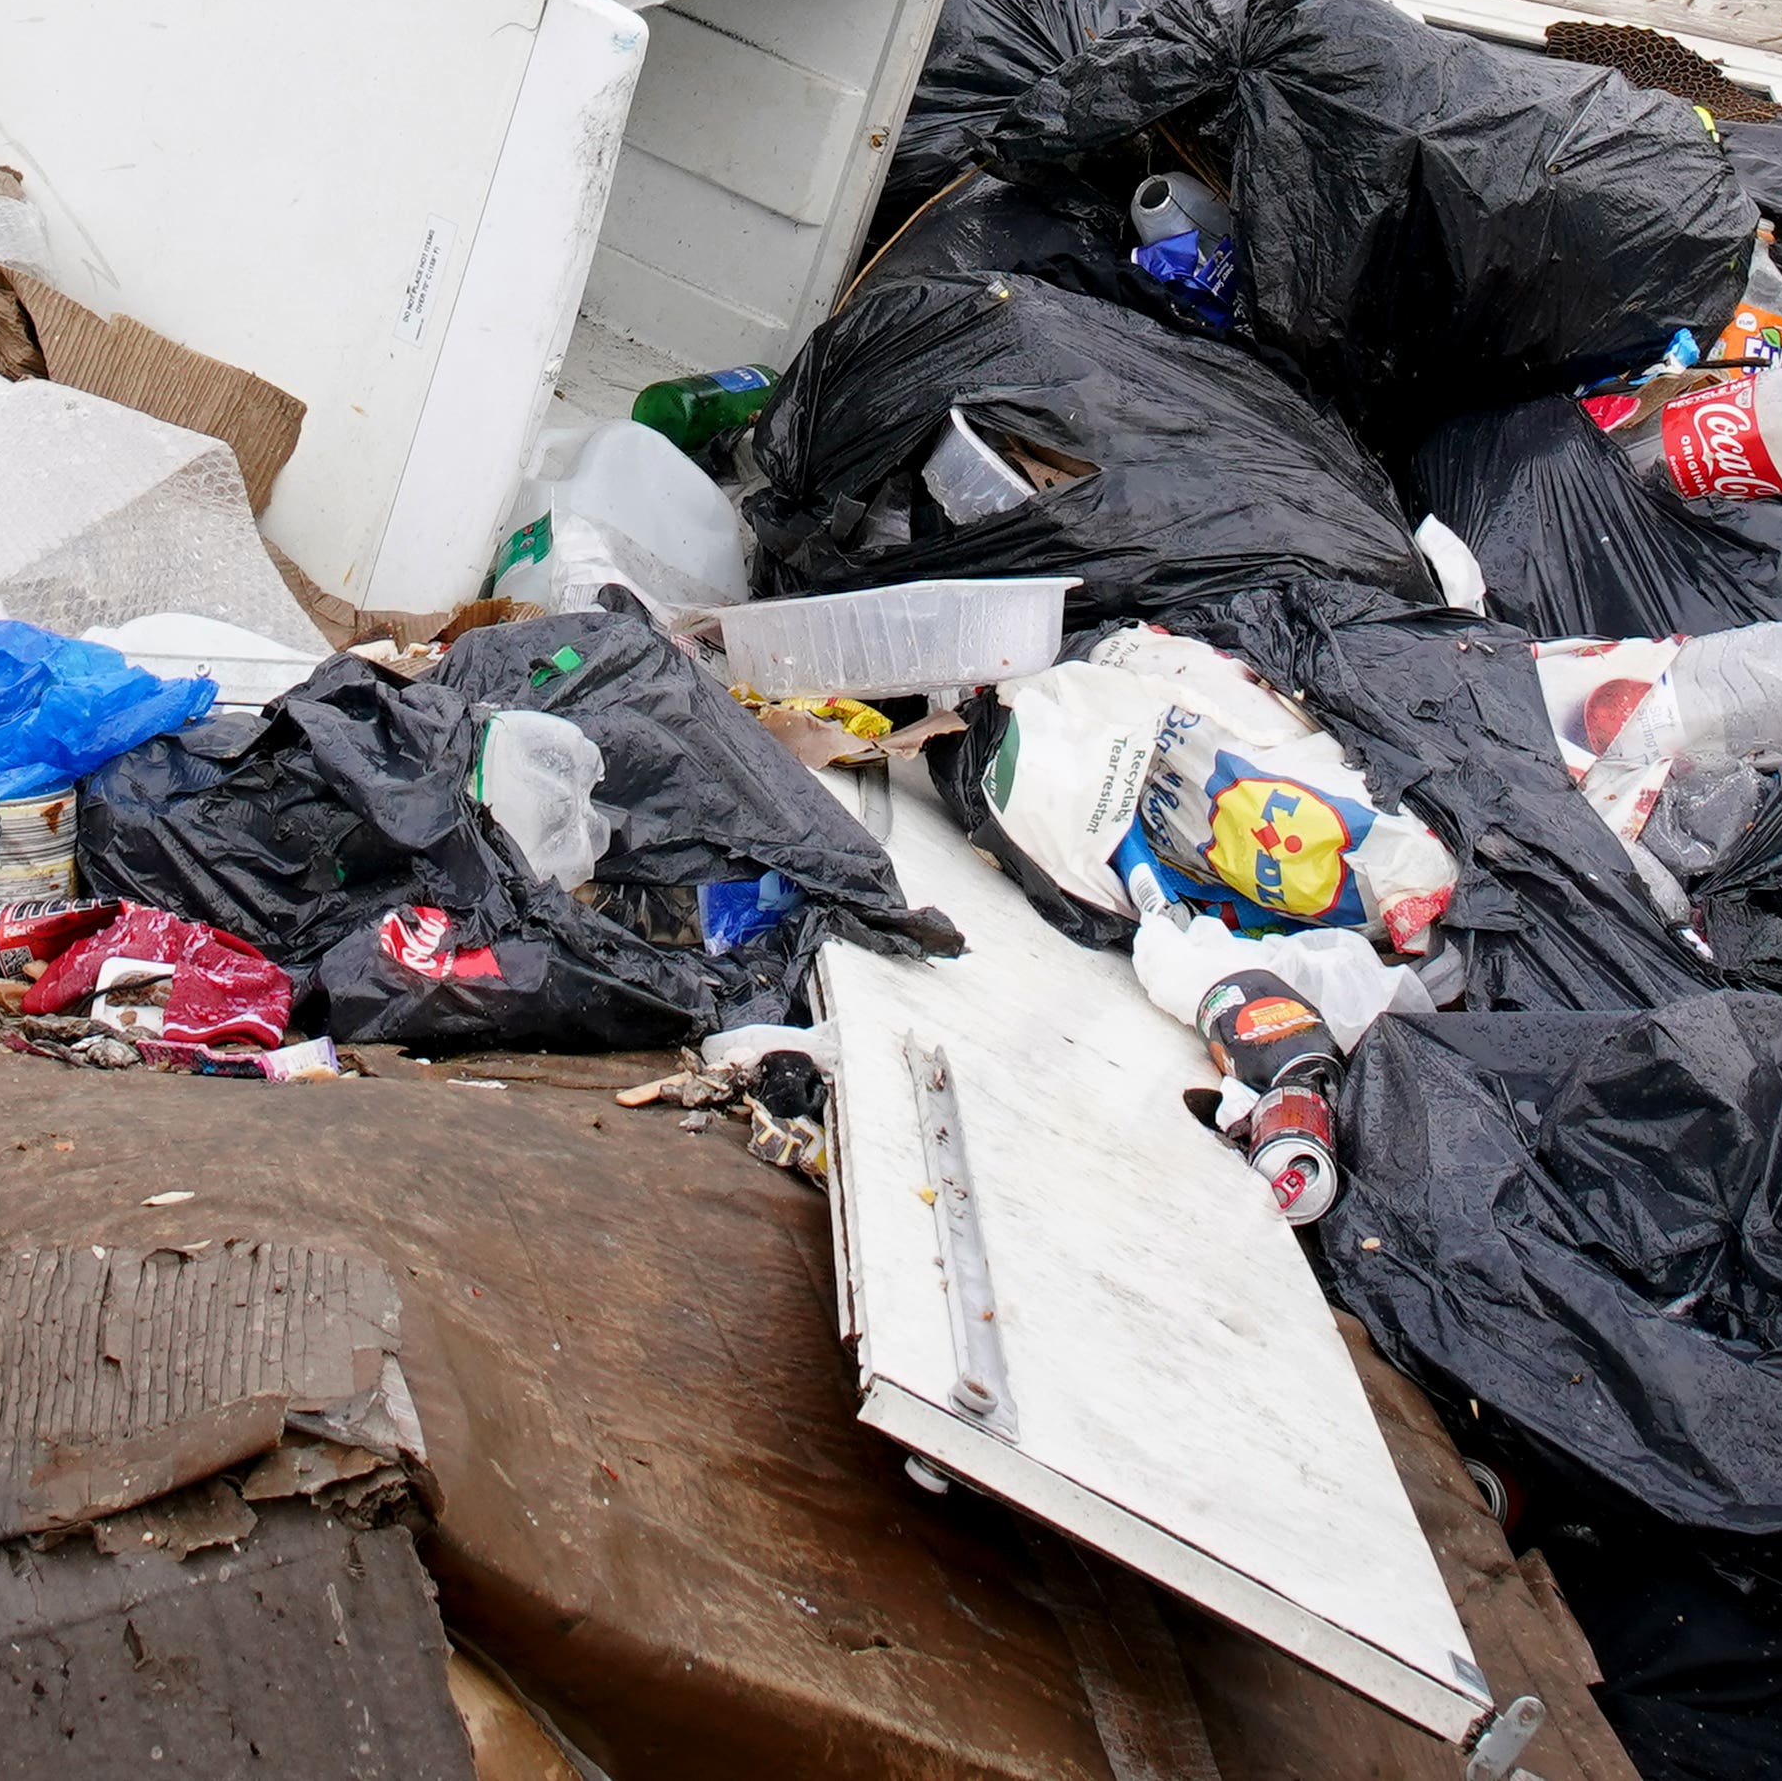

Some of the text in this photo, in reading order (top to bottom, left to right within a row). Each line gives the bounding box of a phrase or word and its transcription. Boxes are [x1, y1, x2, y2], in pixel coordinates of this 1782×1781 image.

[407, 292, 416, 311] NOT
[412, 269, 424, 295] PLACE
[424, 229, 436, 252] ITEMS
[415, 292, 427, 314] OVER
[1666, 387, 1727, 411] RECYCLE
[1727, 378, 1752, 396] ME
[1085, 736, 1128, 836] Tear resistant
